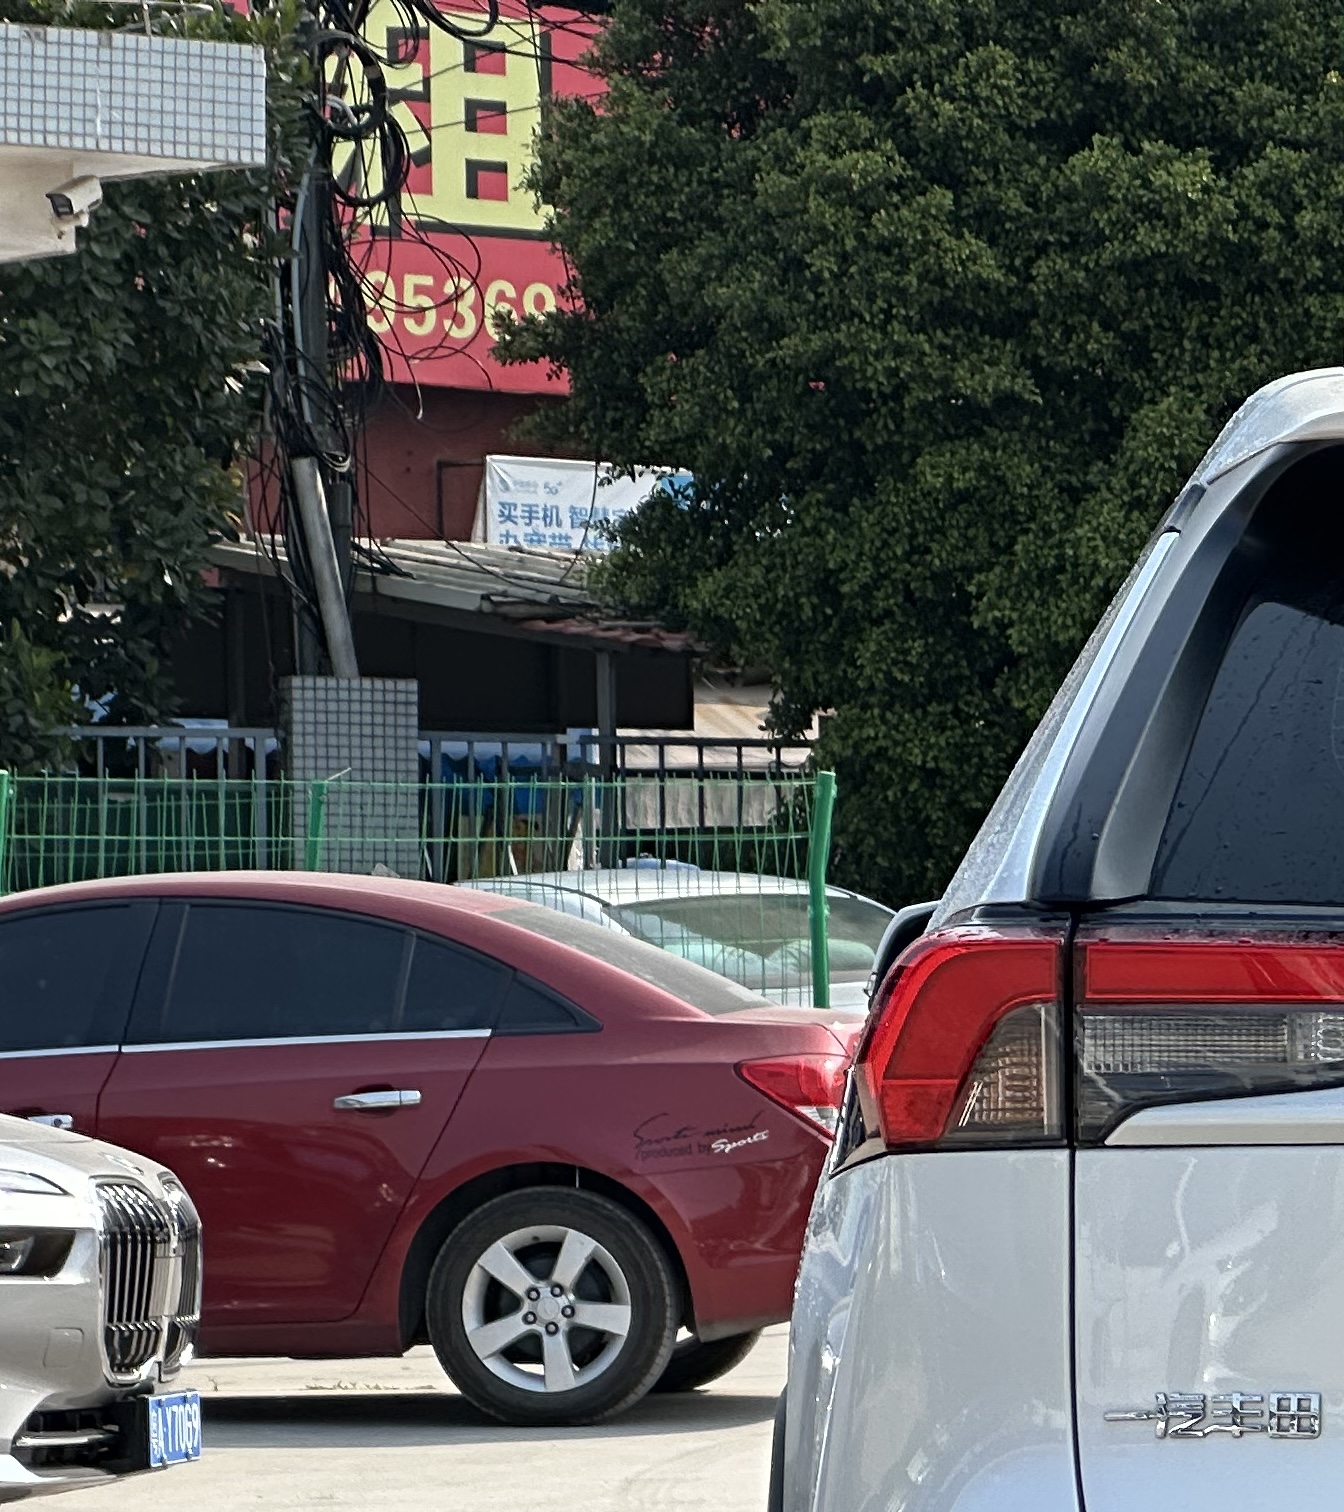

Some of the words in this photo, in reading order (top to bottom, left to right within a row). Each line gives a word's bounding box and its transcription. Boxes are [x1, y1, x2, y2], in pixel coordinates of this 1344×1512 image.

[498, 500, 562, 528] 买手机
[1104, 1392, 1322, 1439] 一汽丰田
